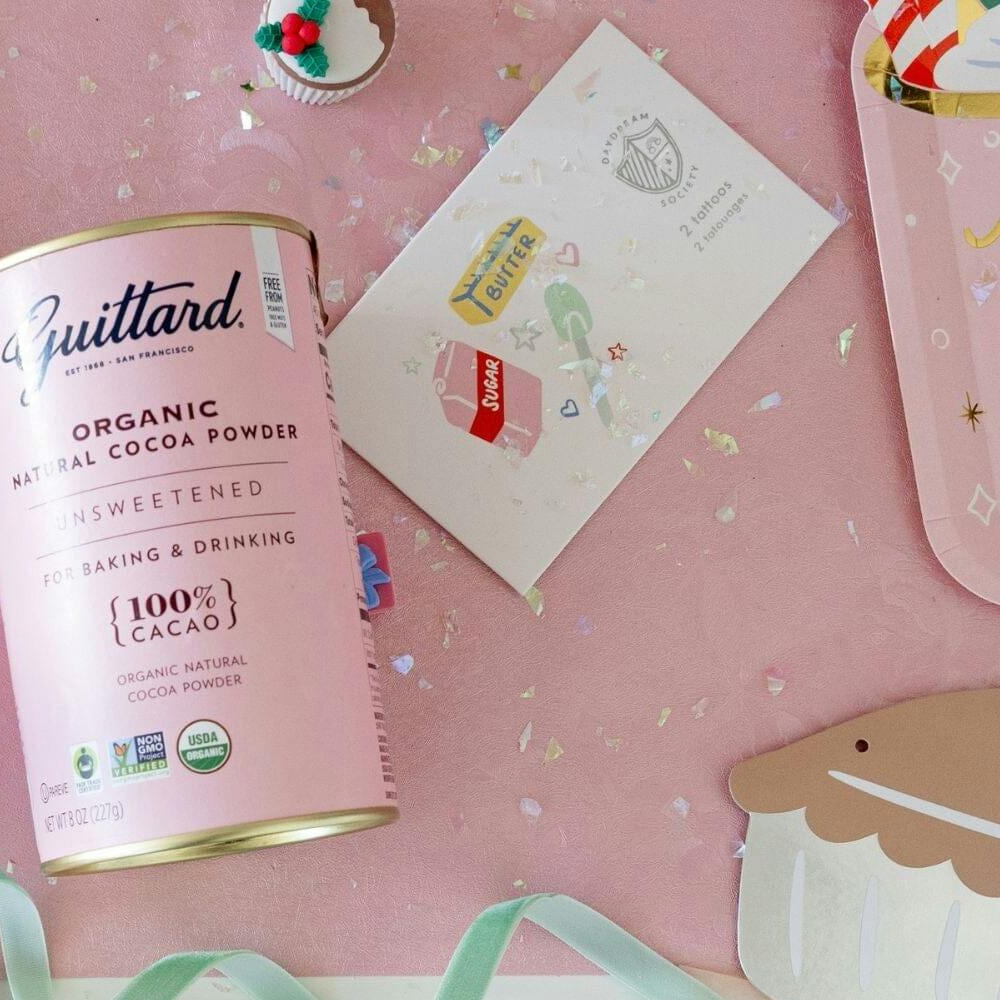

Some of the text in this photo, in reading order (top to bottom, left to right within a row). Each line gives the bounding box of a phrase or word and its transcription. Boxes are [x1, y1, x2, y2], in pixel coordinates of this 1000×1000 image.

[601, 113, 649, 165] DAYDREAM
[660, 165, 699, 207] SOCIETY
[679, 181, 733, 237] 2 tattoos
[693, 192, 749, 253] 2 tatouages
[486, 234, 536, 301] BUTTER
[263, 277, 281, 291] FREE
[265, 291, 283, 303] FROM
[65, 366, 80, 376] EST
[116, 354, 135, 364] SAN
[139, 346, 194, 359] FRANCISCO
[481, 358, 501, 412] SUGAR
[72, 400, 219, 441] ORGANIC
[108, 433, 194, 460] COCOA
[208, 424, 298, 444] POWDER
[56, 480, 262, 531] UNSWEETENED
[82, 548, 160, 576] BAKING
[171, 544, 183, 558] &
[194, 531, 296, 555] DRINKING
[127, 584, 217, 622] 100%
[132, 614, 220, 643] CACAO
[117, 654, 248, 686] ORGANIC NATURAL
[127, 674, 242, 703] COCOA POWDER
[136, 734, 162, 746] NON
[138, 742, 164, 755] GMO
[186, 746, 224, 761] ORGANIC
[188, 731, 218, 746] USDA
[114, 760, 166, 777] VERIFIED
[75, 807, 88, 825] OZ
[90, 800, 124, 824] (227g)
